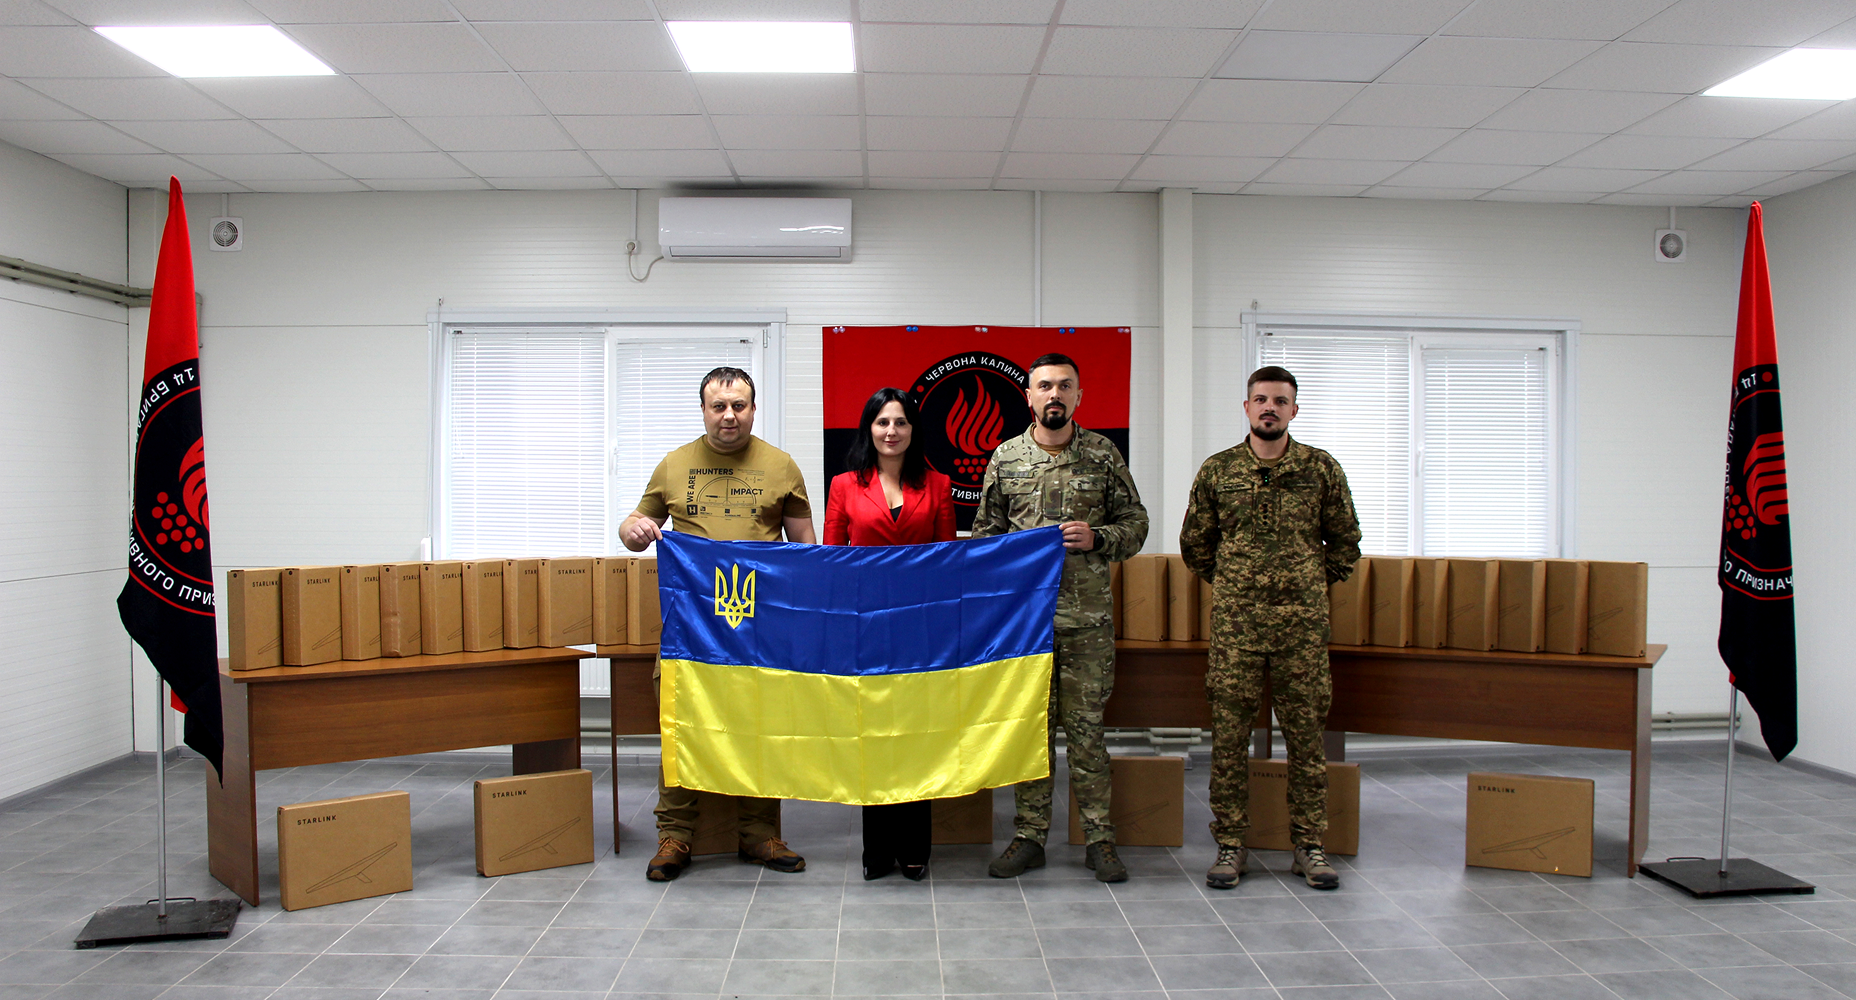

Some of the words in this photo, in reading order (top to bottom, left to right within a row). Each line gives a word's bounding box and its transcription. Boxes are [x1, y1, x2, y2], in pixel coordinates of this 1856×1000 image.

[925, 356, 976, 381] ЧЕРВОНА
[981, 356, 1025, 384] КАЛИНА
[696, 468, 734, 476] HUNTERS
[688, 475, 696, 489] ARE
[686, 491, 695, 503] WE
[730, 488, 763, 496] IMPACT
[951, 487, 983, 500] ТИВН
[252, 580, 278, 588] STARLINK
[1735, 568, 1793, 591] ПРИЗНАЧ
[492, 789, 527, 798] STARLINK
[1478, 785, 1515, 794] STARLINK
[297, 814, 337, 825] STARLINK
